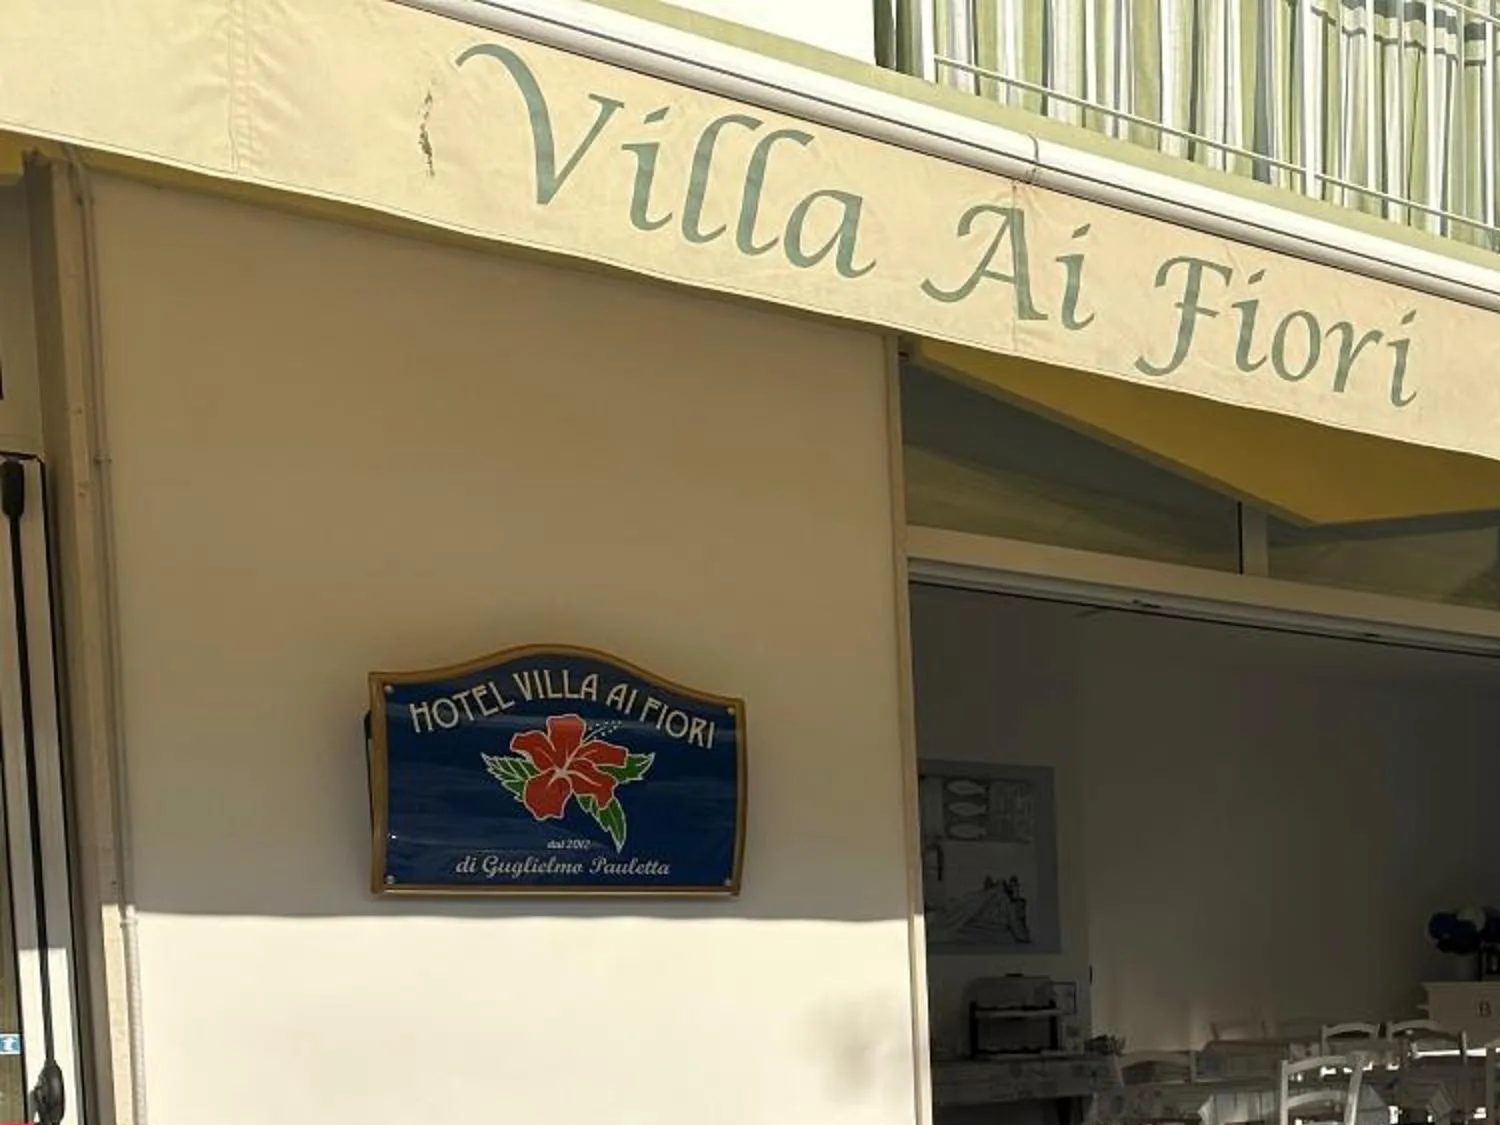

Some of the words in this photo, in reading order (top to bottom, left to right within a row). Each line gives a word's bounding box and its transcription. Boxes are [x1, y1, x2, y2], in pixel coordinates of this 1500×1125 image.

[455, 42, 877, 279] Villa
[921, 203, 1095, 331] Ai
[1134, 255, 1418, 408] Fiori
[409, 681, 515, 733] HOTEL
[513, 669, 599, 701] VILLA
[606, 683, 633, 715] AI
[639, 696, 716, 750] FIORI
[455, 856, 477, 873] di
[481, 855, 585, 878] Guglielmo
[588, 856, 671, 876] Pauletta
